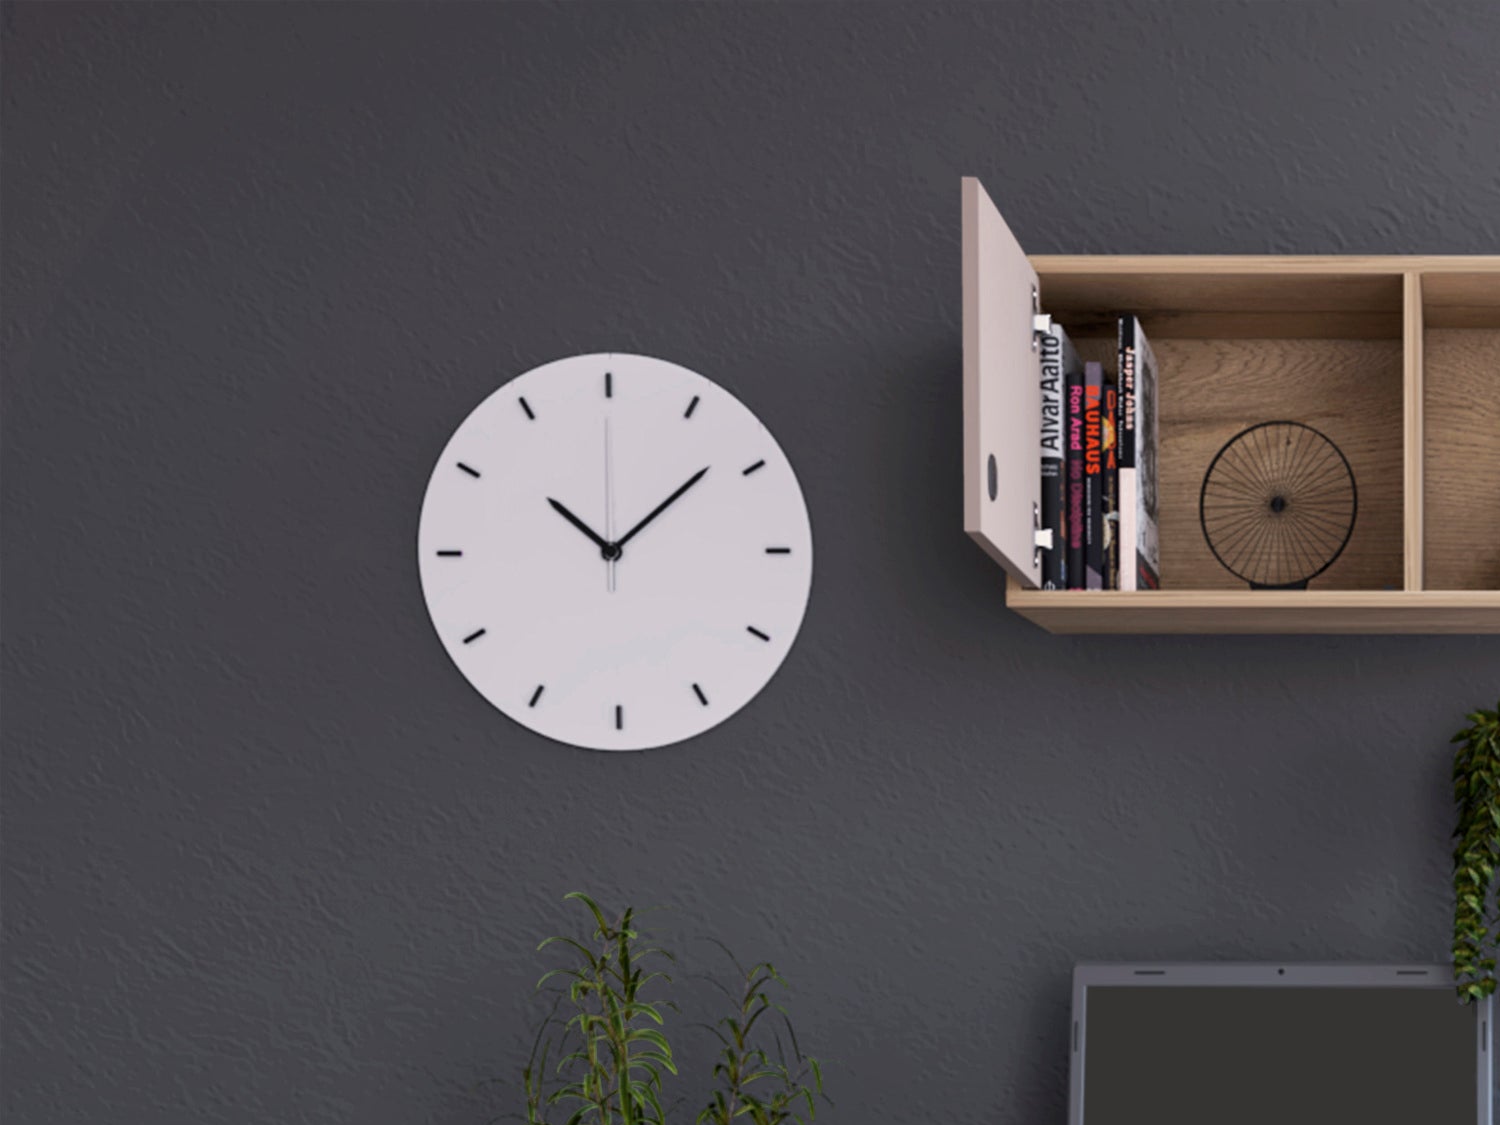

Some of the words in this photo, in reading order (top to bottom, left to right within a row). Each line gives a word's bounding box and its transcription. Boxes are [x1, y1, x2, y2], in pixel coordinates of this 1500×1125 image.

[1124, 346, 1136, 389] Jasper
[1070, 385, 1083, 413] Ron
[1125, 392, 1136, 430] Johns
[1070, 417, 1083, 450] Arad
[1085, 386, 1100, 474] BAUHAUS
